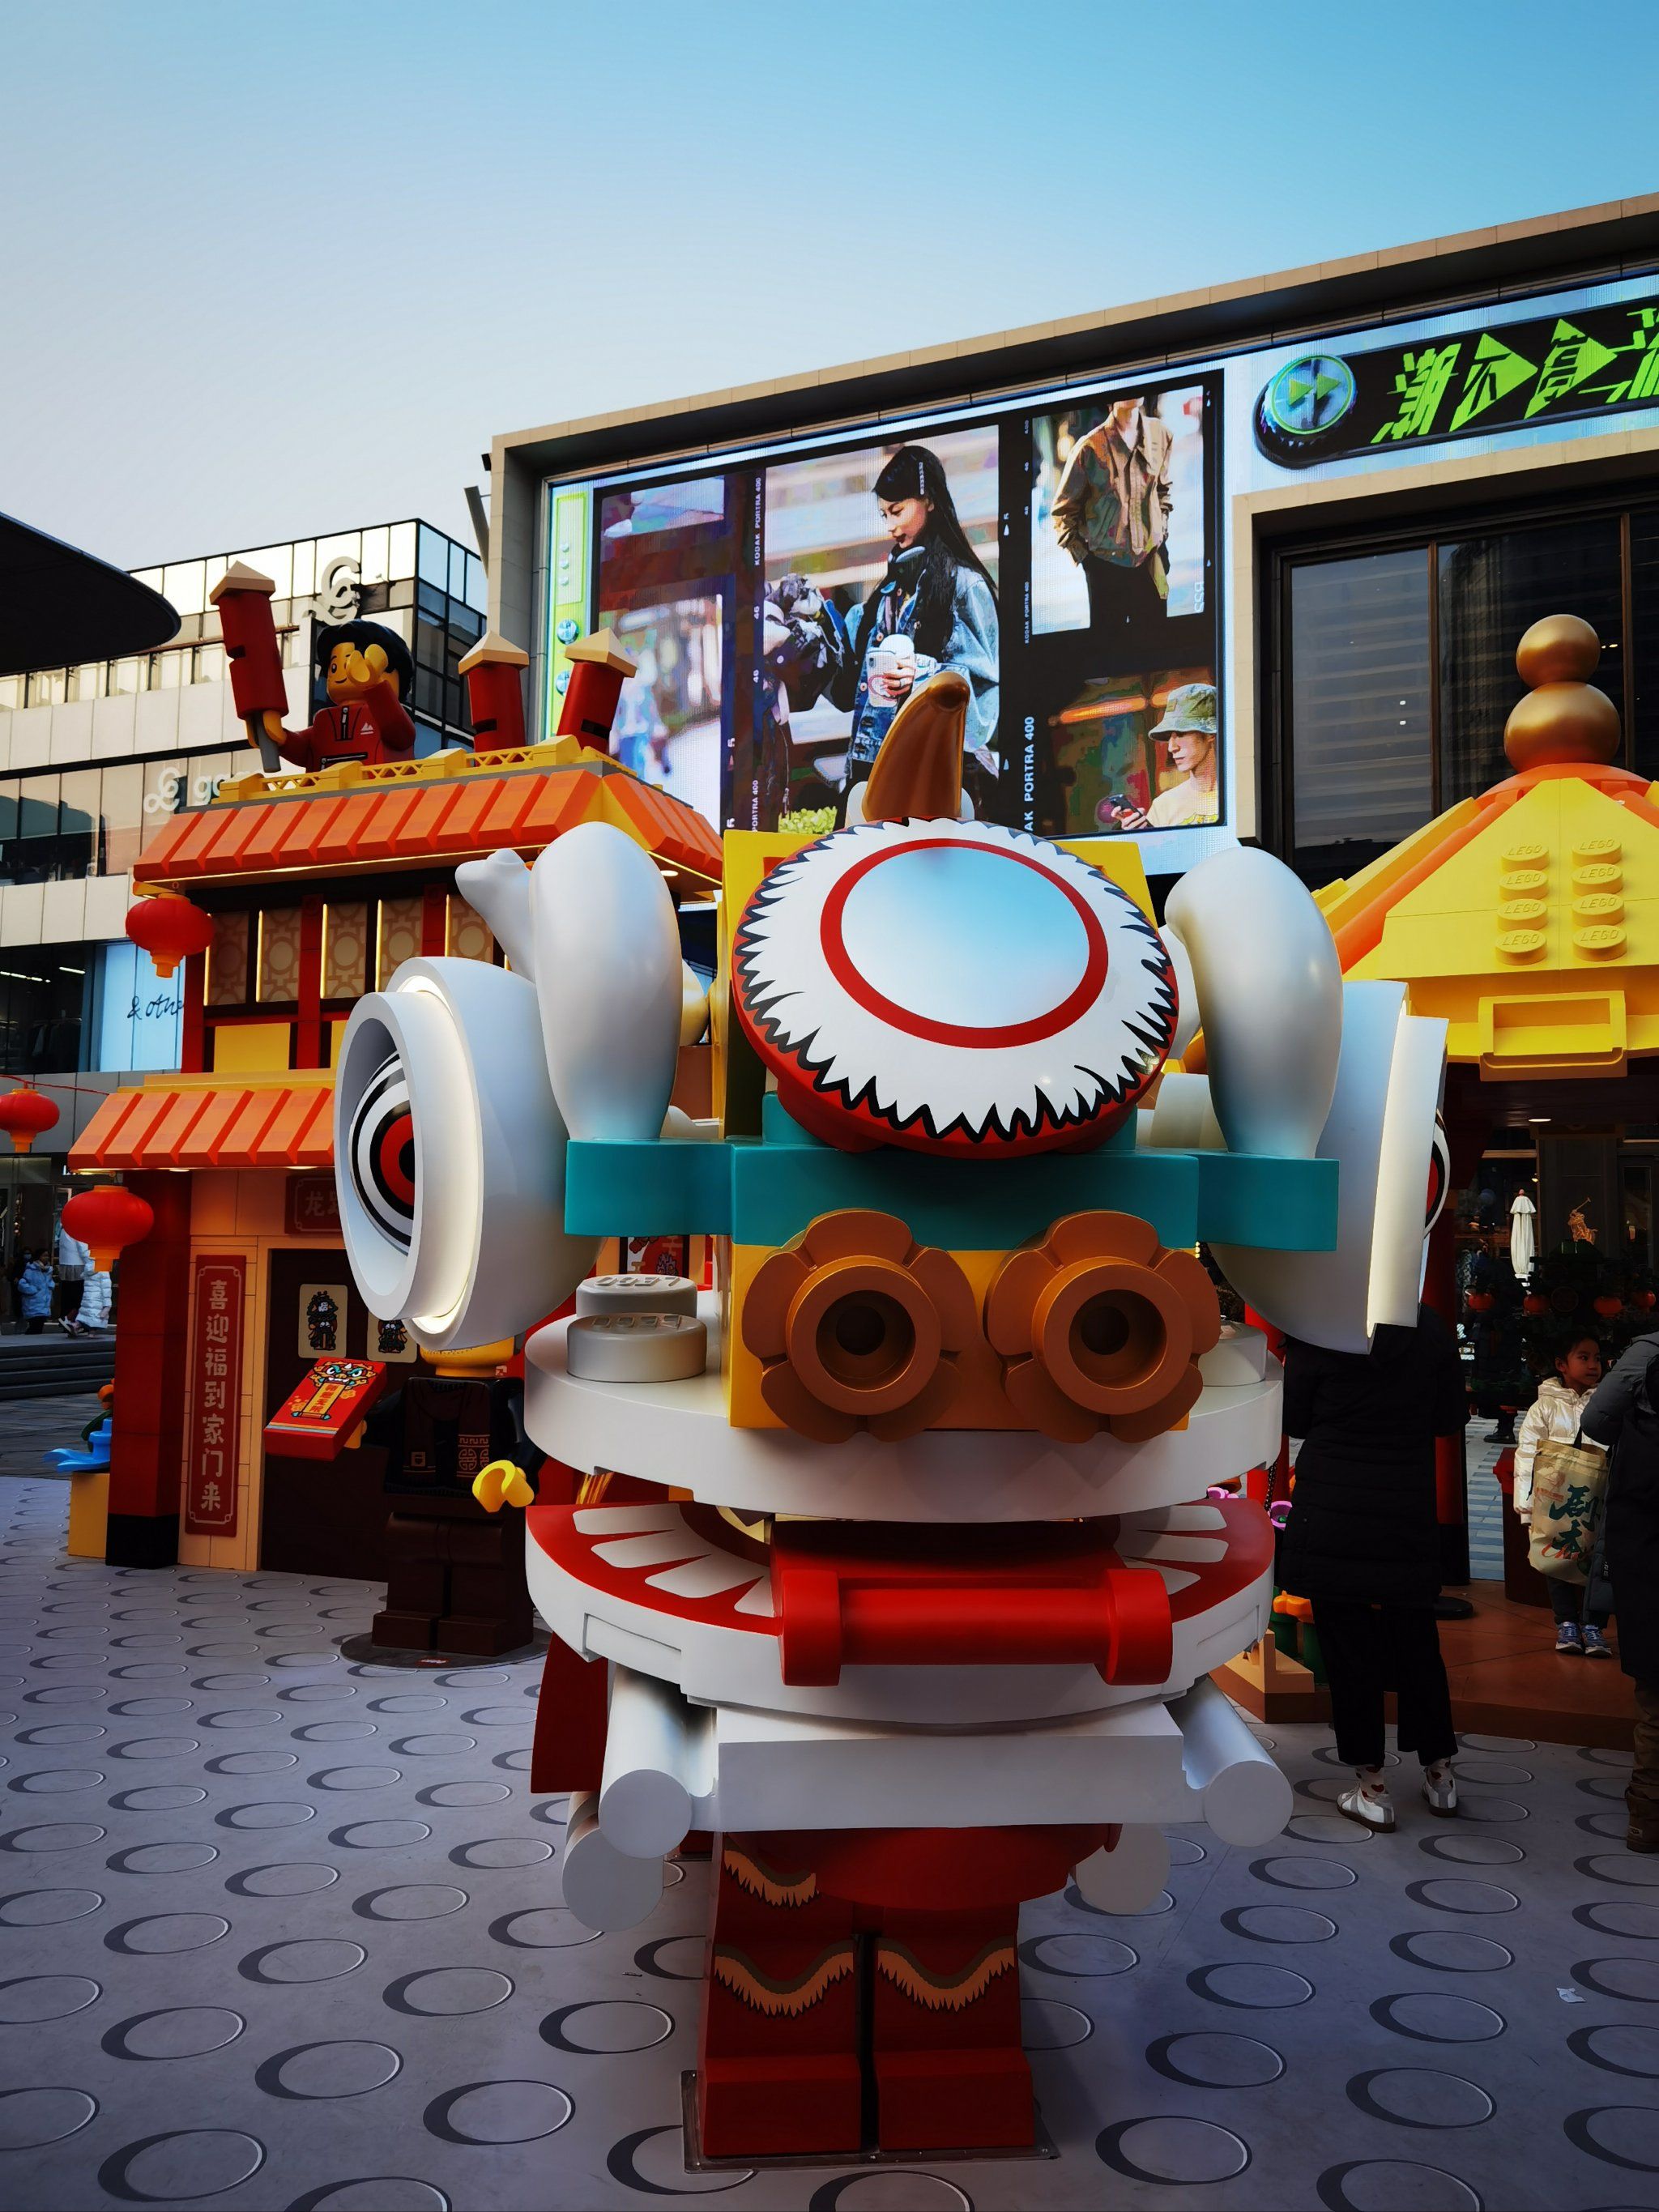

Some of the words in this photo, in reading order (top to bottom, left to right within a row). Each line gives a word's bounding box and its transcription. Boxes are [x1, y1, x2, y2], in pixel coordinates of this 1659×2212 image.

[1024, 716, 1035, 741] 400
[1023, 744, 1034, 802] PORTRA
[1023, 810, 1034, 832] AK
[1507, 845, 1542, 856] LEGO
[1580, 838, 1615, 850] LEGO
[1506, 873, 1542, 885] LEGO
[1580, 867, 1616, 879] LEGO
[1503, 902, 1541, 914] LEGO
[1580, 897, 1618, 909] LEGO
[1502, 933, 1540, 946] LEGO
[1580, 929, 1619, 942] LEGO
[145, 993, 184, 1019] othe
[200, 1279, 229, 1512] 喜迎福到家门来
